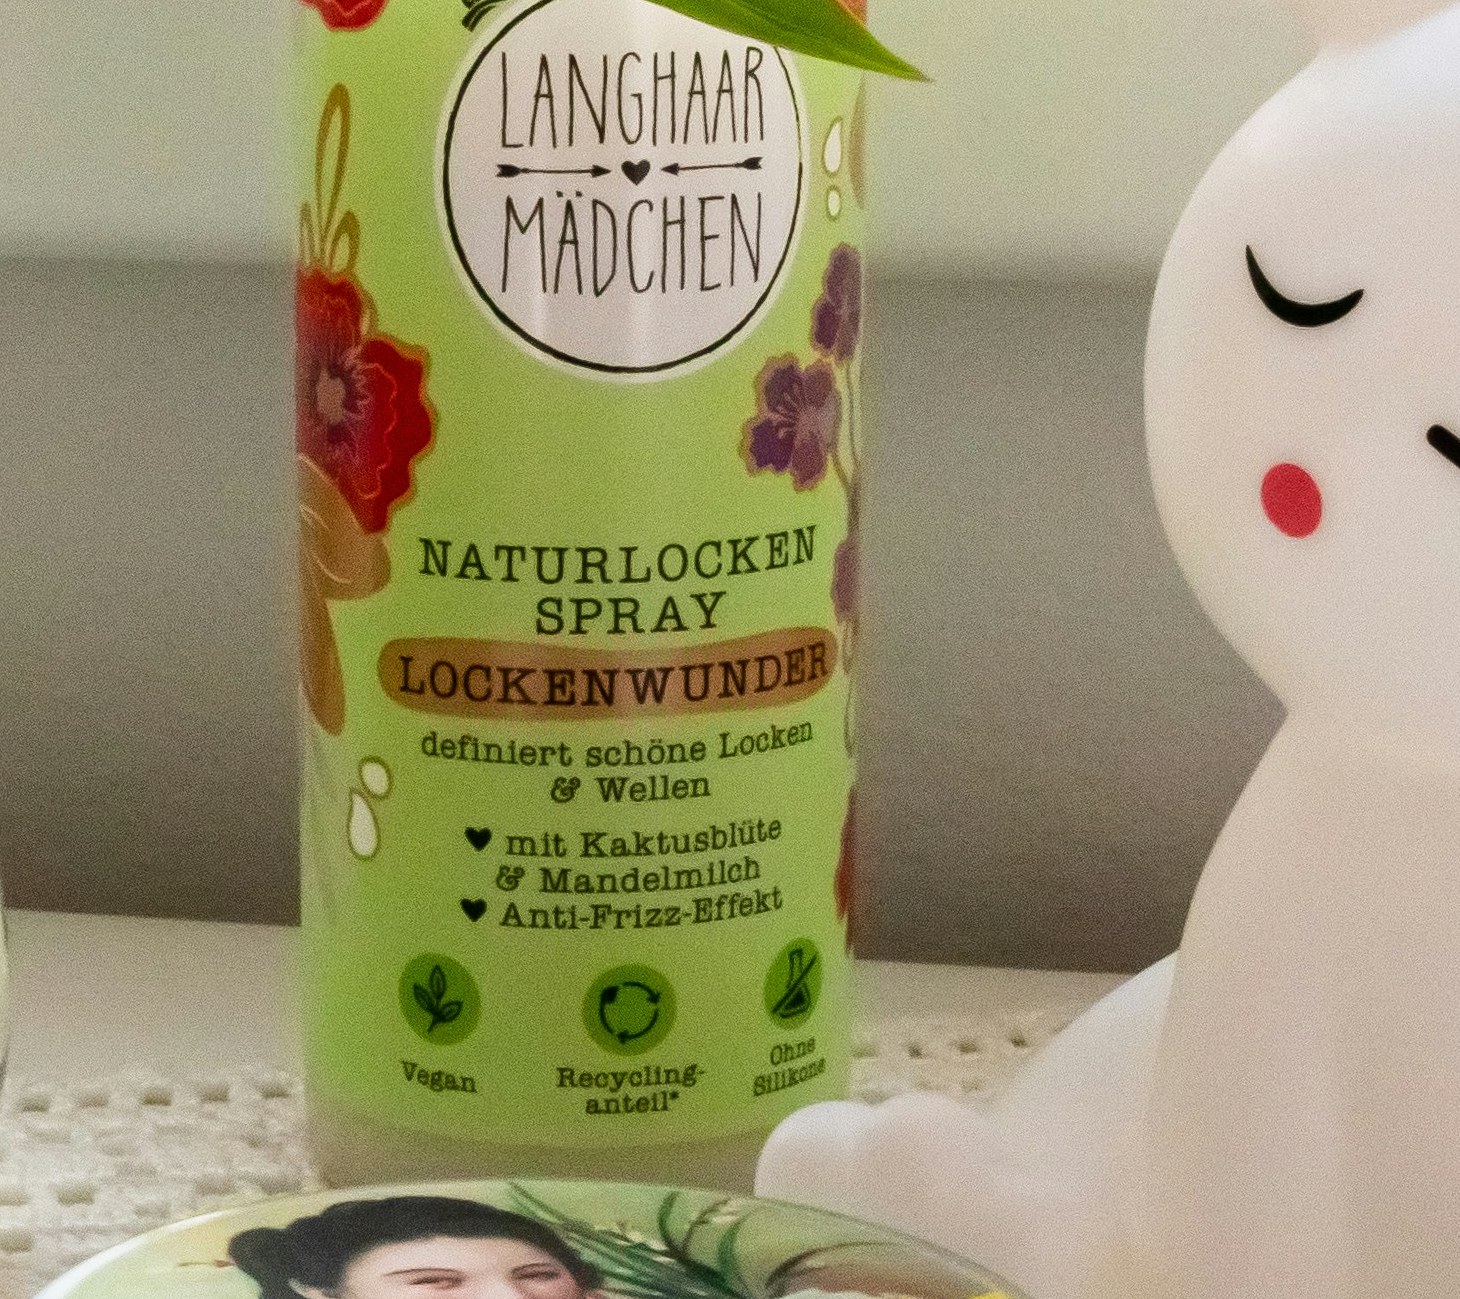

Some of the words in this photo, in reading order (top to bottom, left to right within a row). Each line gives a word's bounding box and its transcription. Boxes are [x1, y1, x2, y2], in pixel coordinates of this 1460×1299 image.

[501, 46, 766, 149] LANGHAAR
[500, 190, 763, 297] MÄDCHEN
[418, 526, 817, 584] NATURLOCKEN
[535, 592, 727, 635] SPRAY
[399, 640, 829, 706] LOCKENWUNDER
[421, 732, 571, 766] definiert
[585, 736, 706, 767] schöne
[718, 721, 813, 759] Locken
[550, 776, 581, 802] &
[597, 773, 711, 803] Wellen
[506, 831, 567, 857] mit
[580, 818, 782, 857] Kaktusblüte
[495, 865, 524, 891] &
[540, 858, 760, 894] Mandelmilch
[499, 888, 784, 930] Anti-Frizz-Effekt
[770, 1037, 816, 1066] Ohne
[401, 1061, 478, 1093] Vegan
[557, 1063, 706, 1093] Recycling-
[753, 1057, 827, 1097] Silikone
